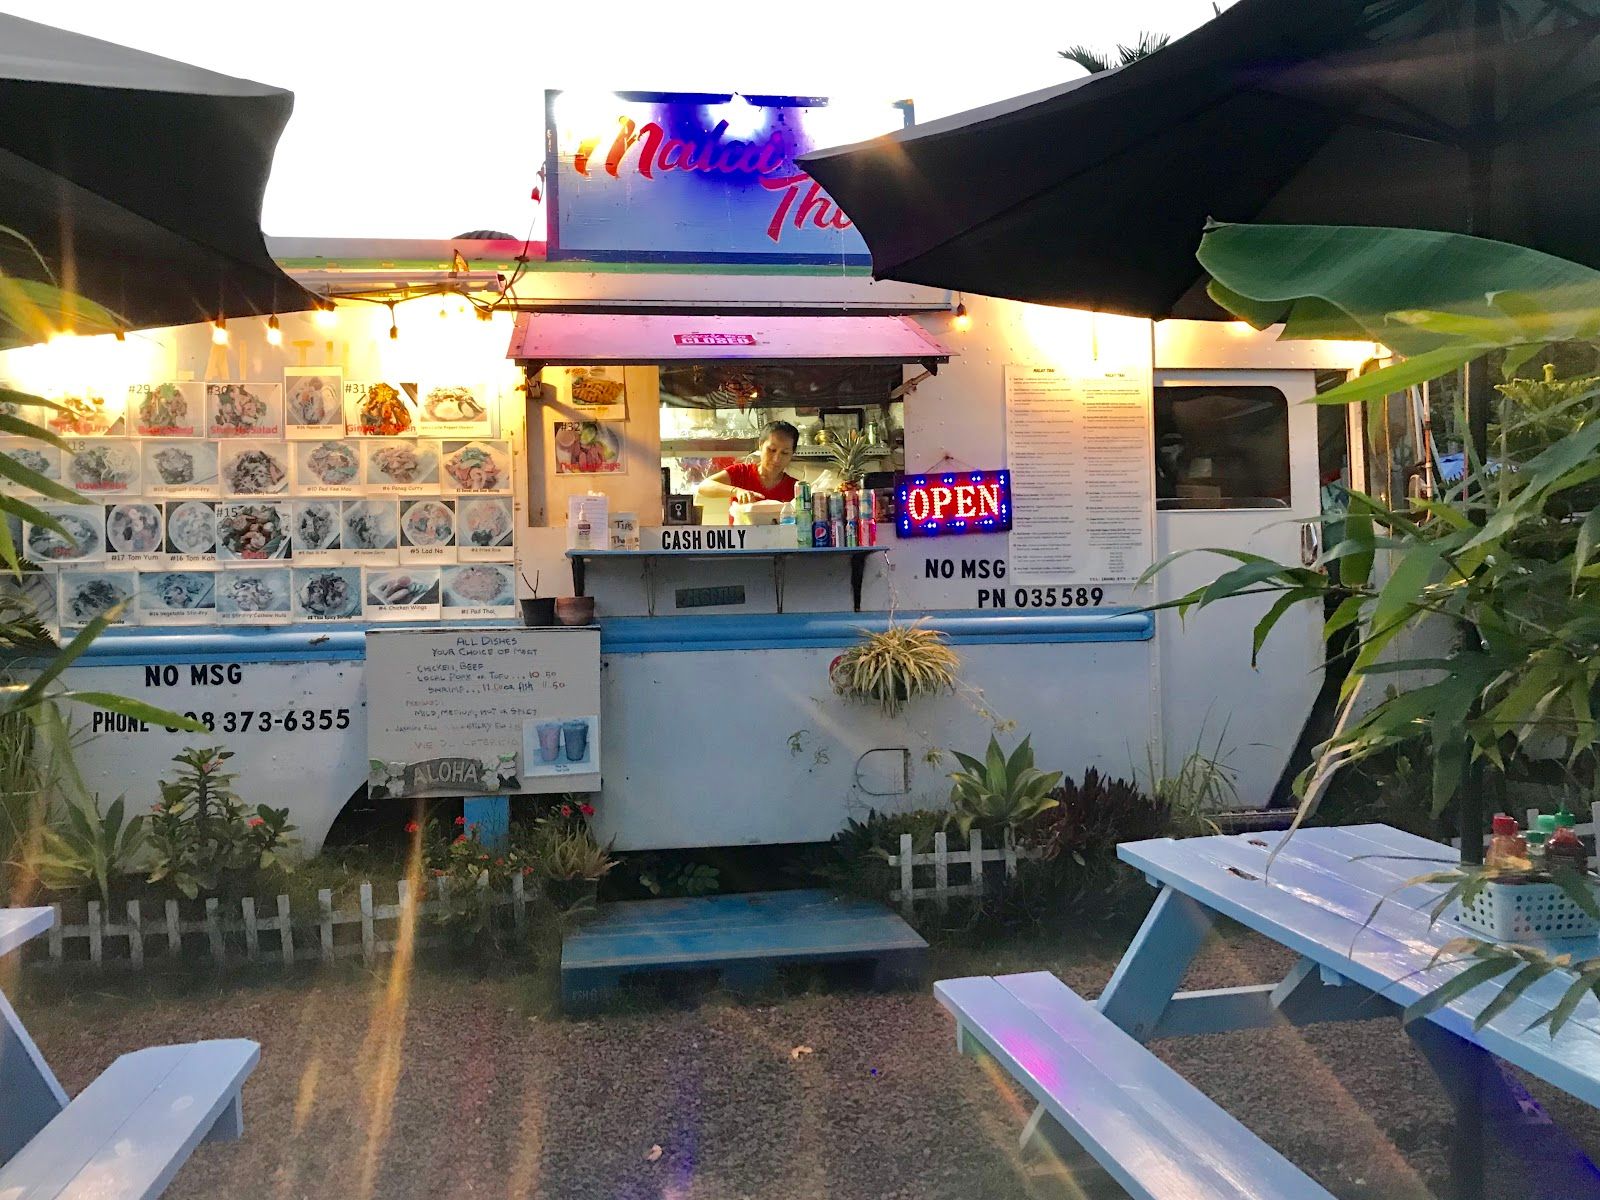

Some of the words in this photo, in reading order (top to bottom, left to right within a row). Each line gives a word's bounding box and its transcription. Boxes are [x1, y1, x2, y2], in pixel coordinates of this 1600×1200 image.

[345, 383, 366, 394] #31
[561, 421, 580, 432] #32
[908, 484, 999, 520] OPEN
[216, 507, 238, 518] #15
[662, 530, 702, 550] CASH
[706, 529, 747, 550] ONLY
[925, 559, 955, 579] NO
[961, 559, 1006, 579] MSG
[977, 588, 1006, 608] PN
[1014, 587, 1104, 607] 035589
[456, 637, 479, 646] ALL
[481, 636, 518, 646] DISHES
[431, 648, 456, 657] YOUR
[457, 647, 494, 656] CHOICE
[497, 648, 511, 656] OF
[145, 665, 179, 687] NO
[190, 663, 242, 686] MSG
[92, 711, 150, 733] PHONE
[223, 709, 351, 733] 373-6355
[413, 760, 480, 787] ALOHA
